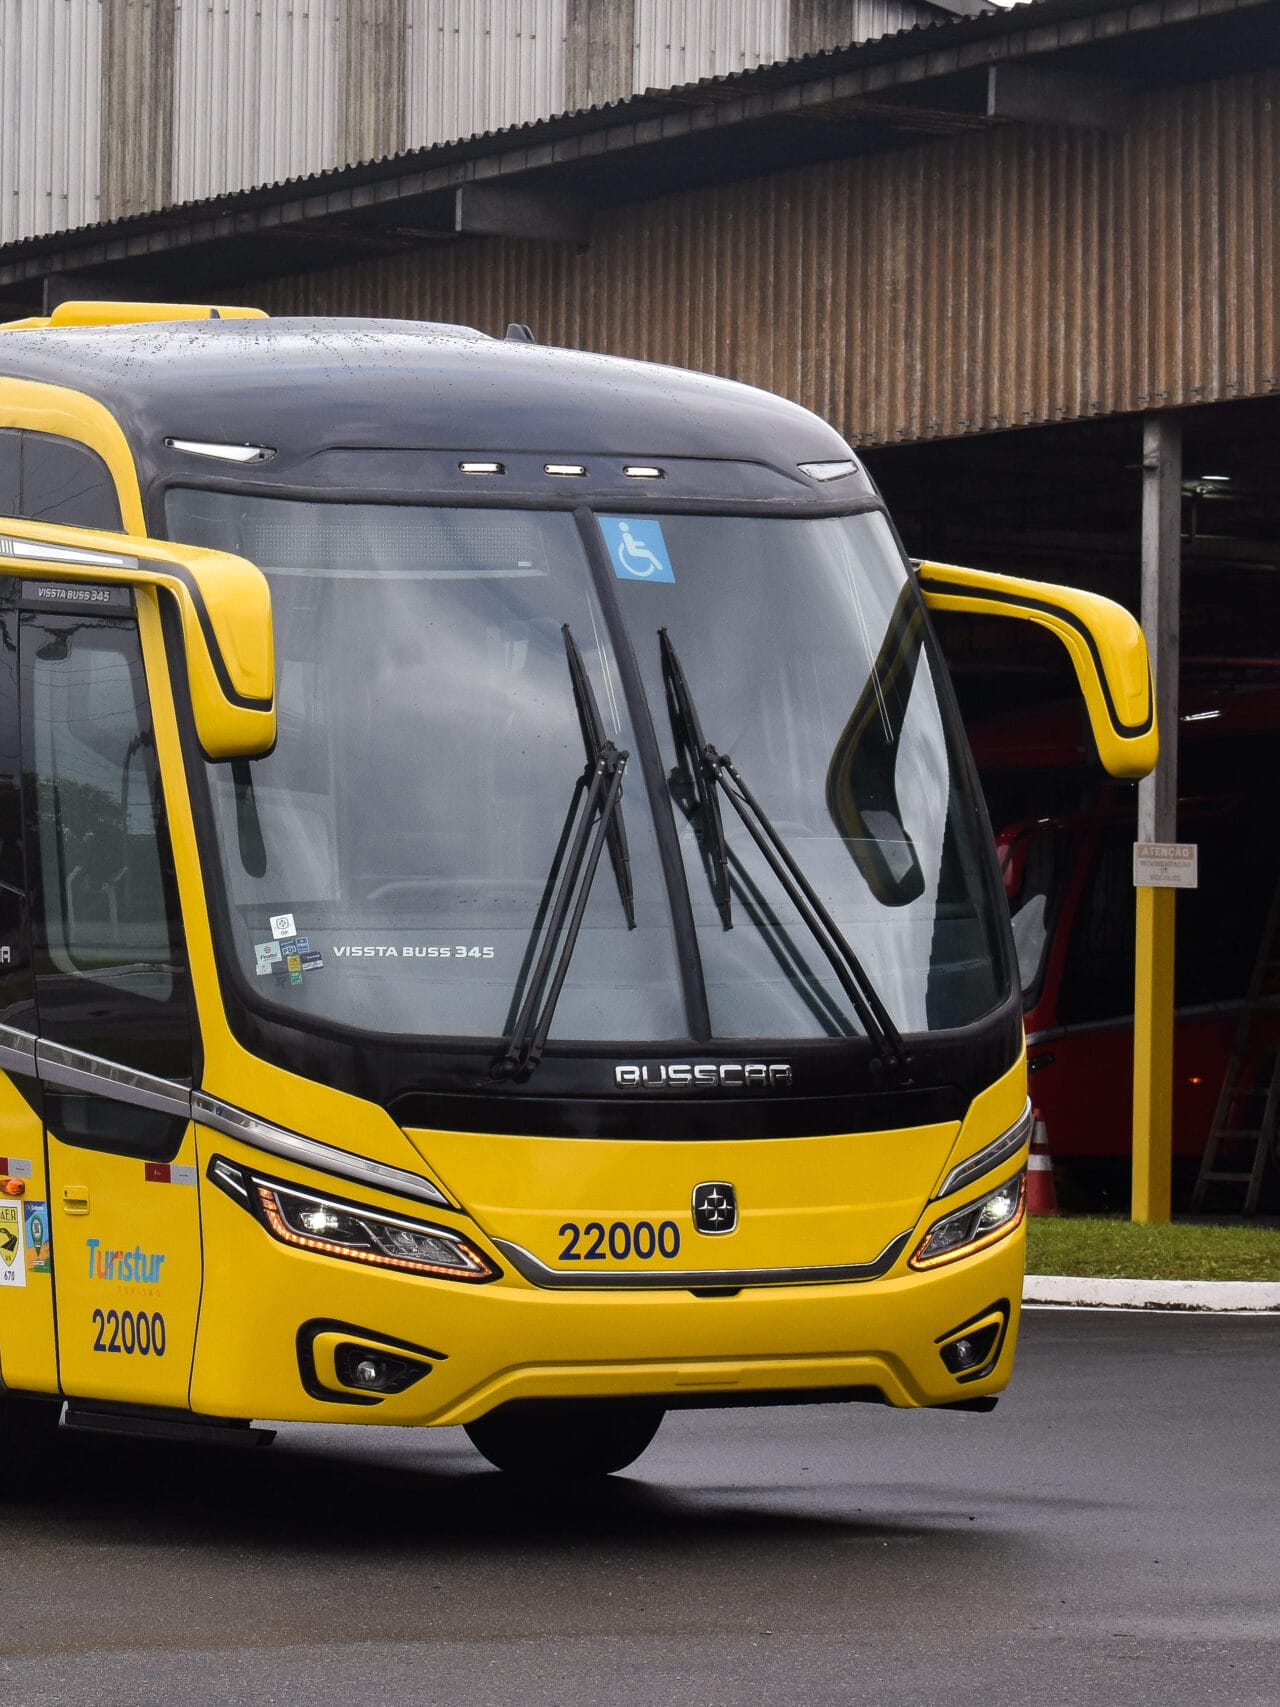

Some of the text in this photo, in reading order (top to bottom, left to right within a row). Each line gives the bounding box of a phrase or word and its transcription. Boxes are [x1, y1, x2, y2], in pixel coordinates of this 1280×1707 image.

[38, 587, 111, 602] VISSTA BUSS 345
[332, 946, 399, 957] VISSTA
[402, 946, 452, 958] BUSS
[454, 945, 495, 959] 345
[615, 1064, 793, 1089] BUSSCAR
[558, 1220, 681, 1261] 22000
[86, 1238, 166, 1284] Turistur
[92, 1308, 167, 1357] 22000
